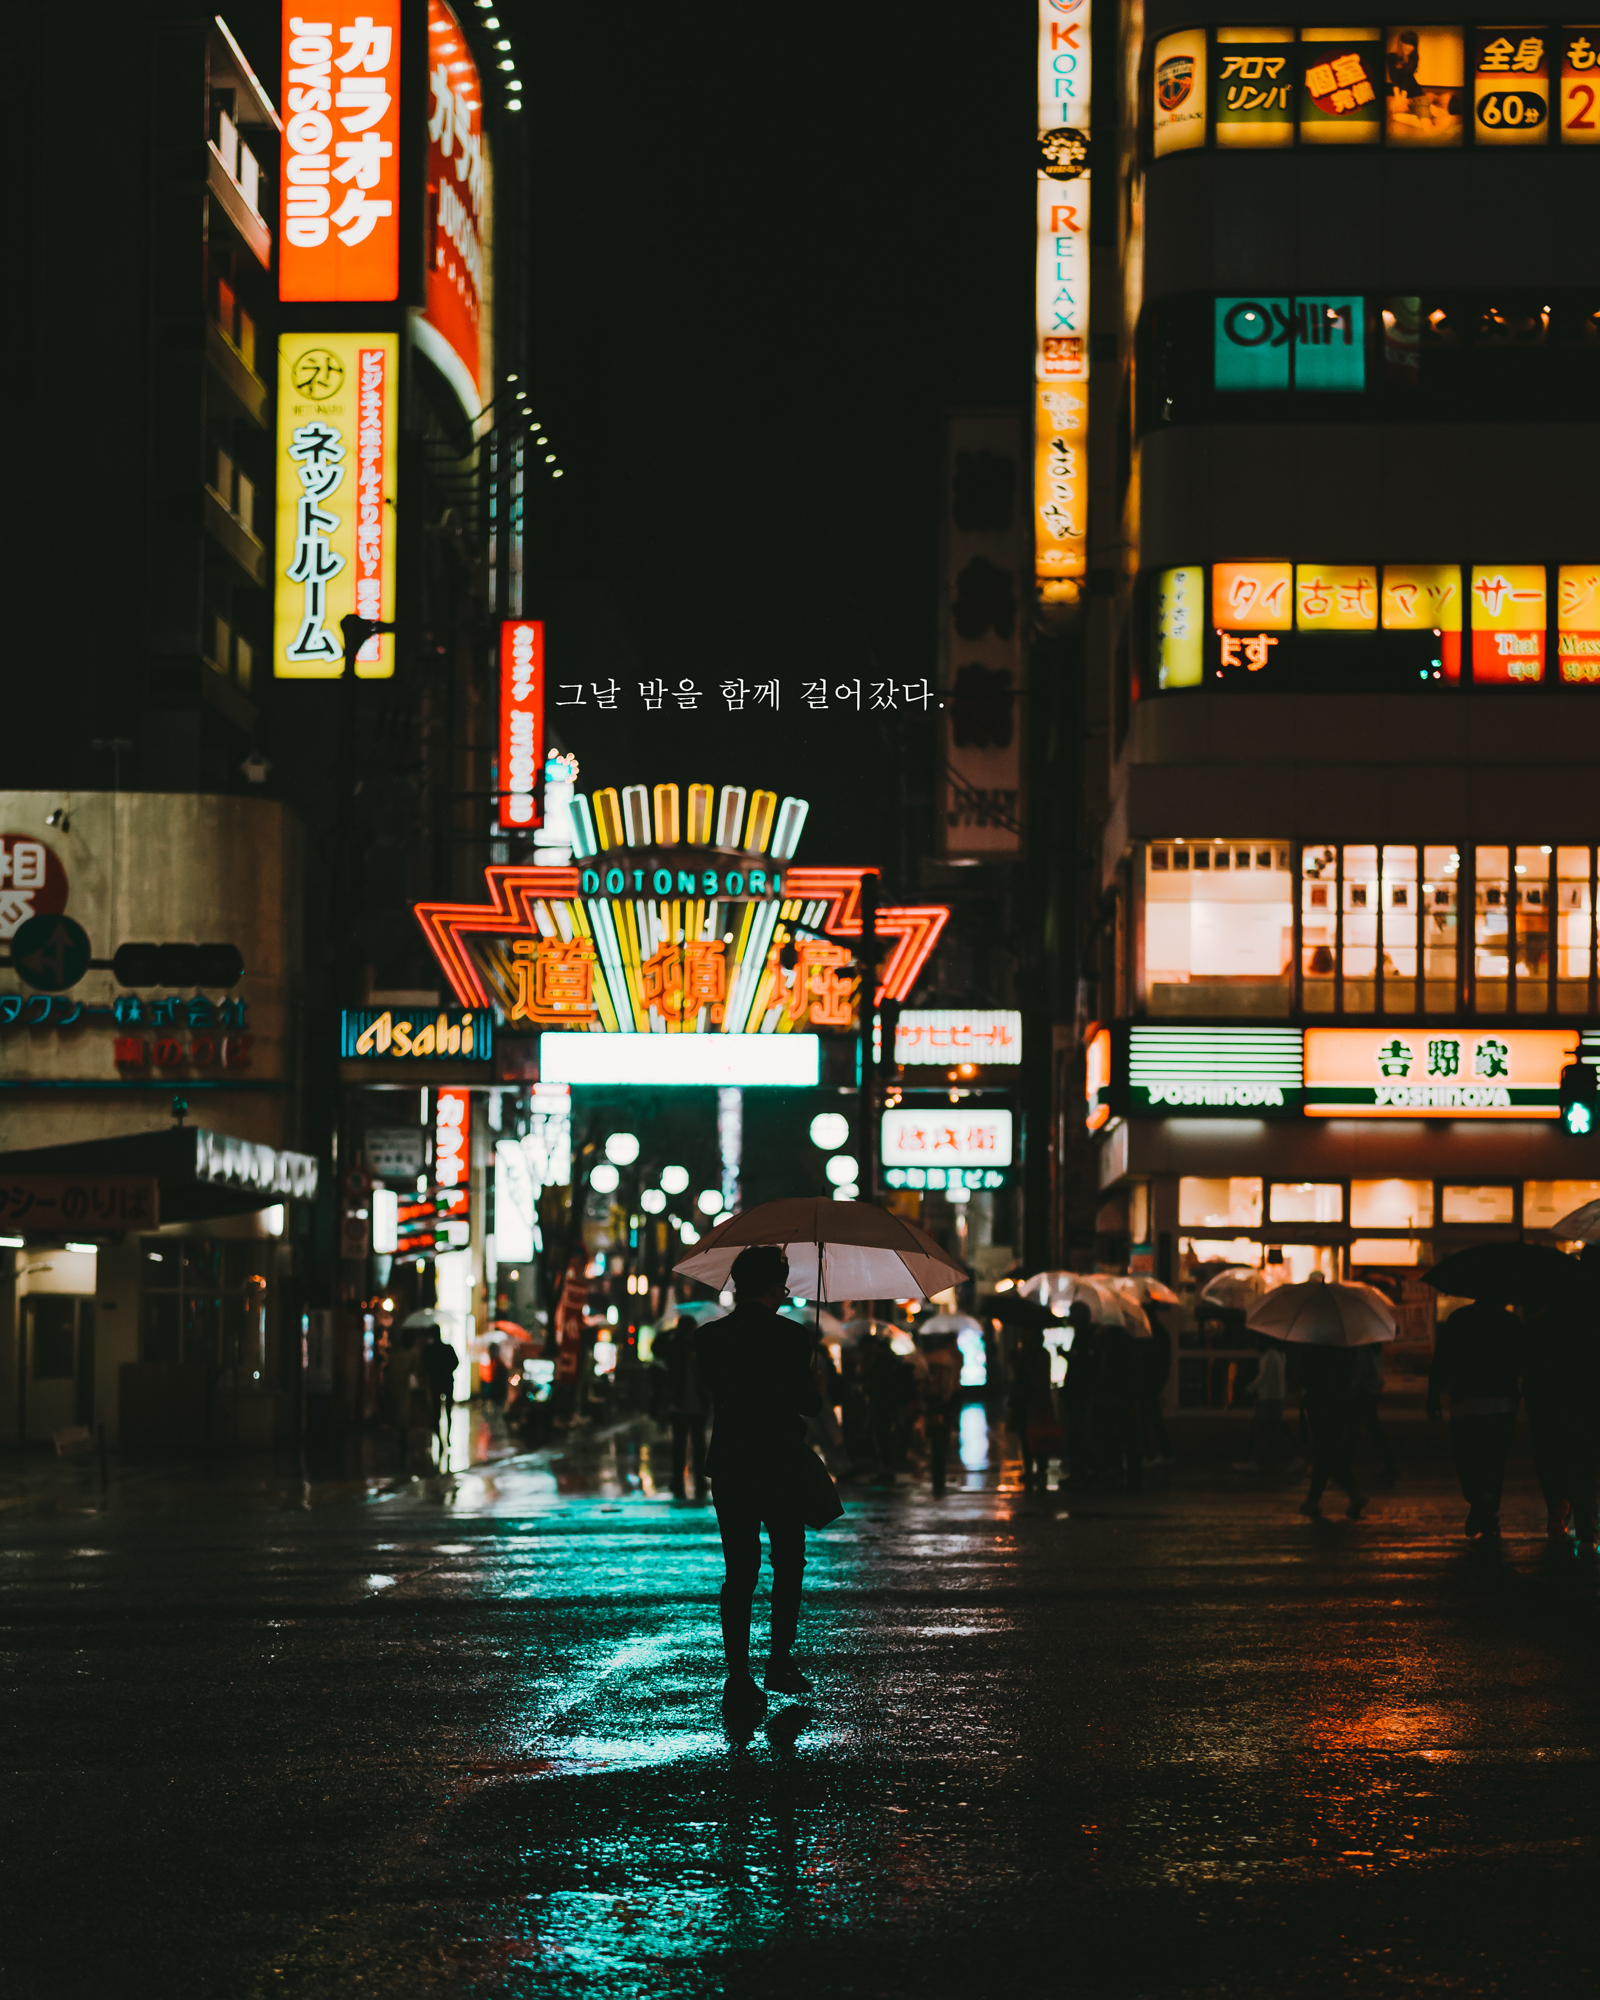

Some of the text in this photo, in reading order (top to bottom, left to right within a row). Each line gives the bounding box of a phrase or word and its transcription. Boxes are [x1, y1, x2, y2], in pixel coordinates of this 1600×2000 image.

[1219, 56, 1286, 80] アロマ
[1479, 36, 1544, 72] 全身
[1566, 36, 1600, 70] も
[1050, 21, 1081, 123] KORI
[1304, 53, 1368, 99] 個室
[1227, 84, 1293, 110] リンパ
[1482, 94, 1541, 126] 60分
[286, 17, 333, 248] JOYSOUND
[330, 16, 392, 247] カラオケ
[1049, 205, 1082, 331] RELAX
[286, 422, 346, 662] ネットルーム
[1494, 632, 1540, 656] Thai
[582, 867, 781, 896] DOTONBORI
[356, 1011, 474, 1057] Asahi
[894, 1024, 1014, 1047] サヒビール
[1377, 1039, 1509, 1077] 吉野家
